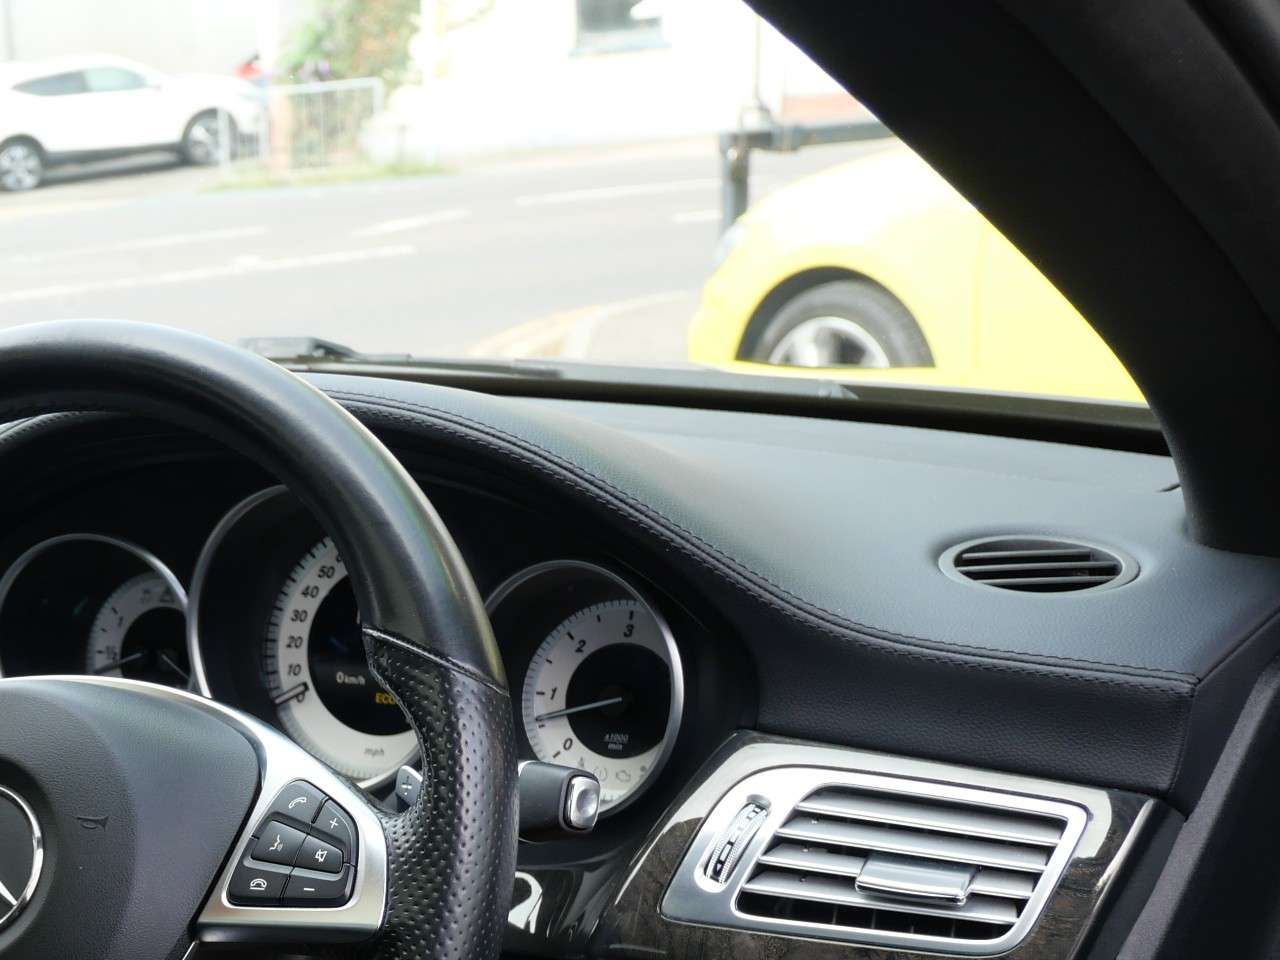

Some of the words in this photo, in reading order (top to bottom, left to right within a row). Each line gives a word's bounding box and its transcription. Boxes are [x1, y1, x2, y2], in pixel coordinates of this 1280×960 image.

[318, 565, 335, 579] 50
[301, 585, 319, 598] 40
[290, 609, 307, 623] 30
[623, 623, 634, 638] 3
[286, 636, 303, 649] 20
[575, 640, 587, 653] 2
[287, 664, 302, 677] 10
[336, 672, 343, 684] 0
[550, 687, 557, 700] 1
[563, 738, 573, 751] 0
